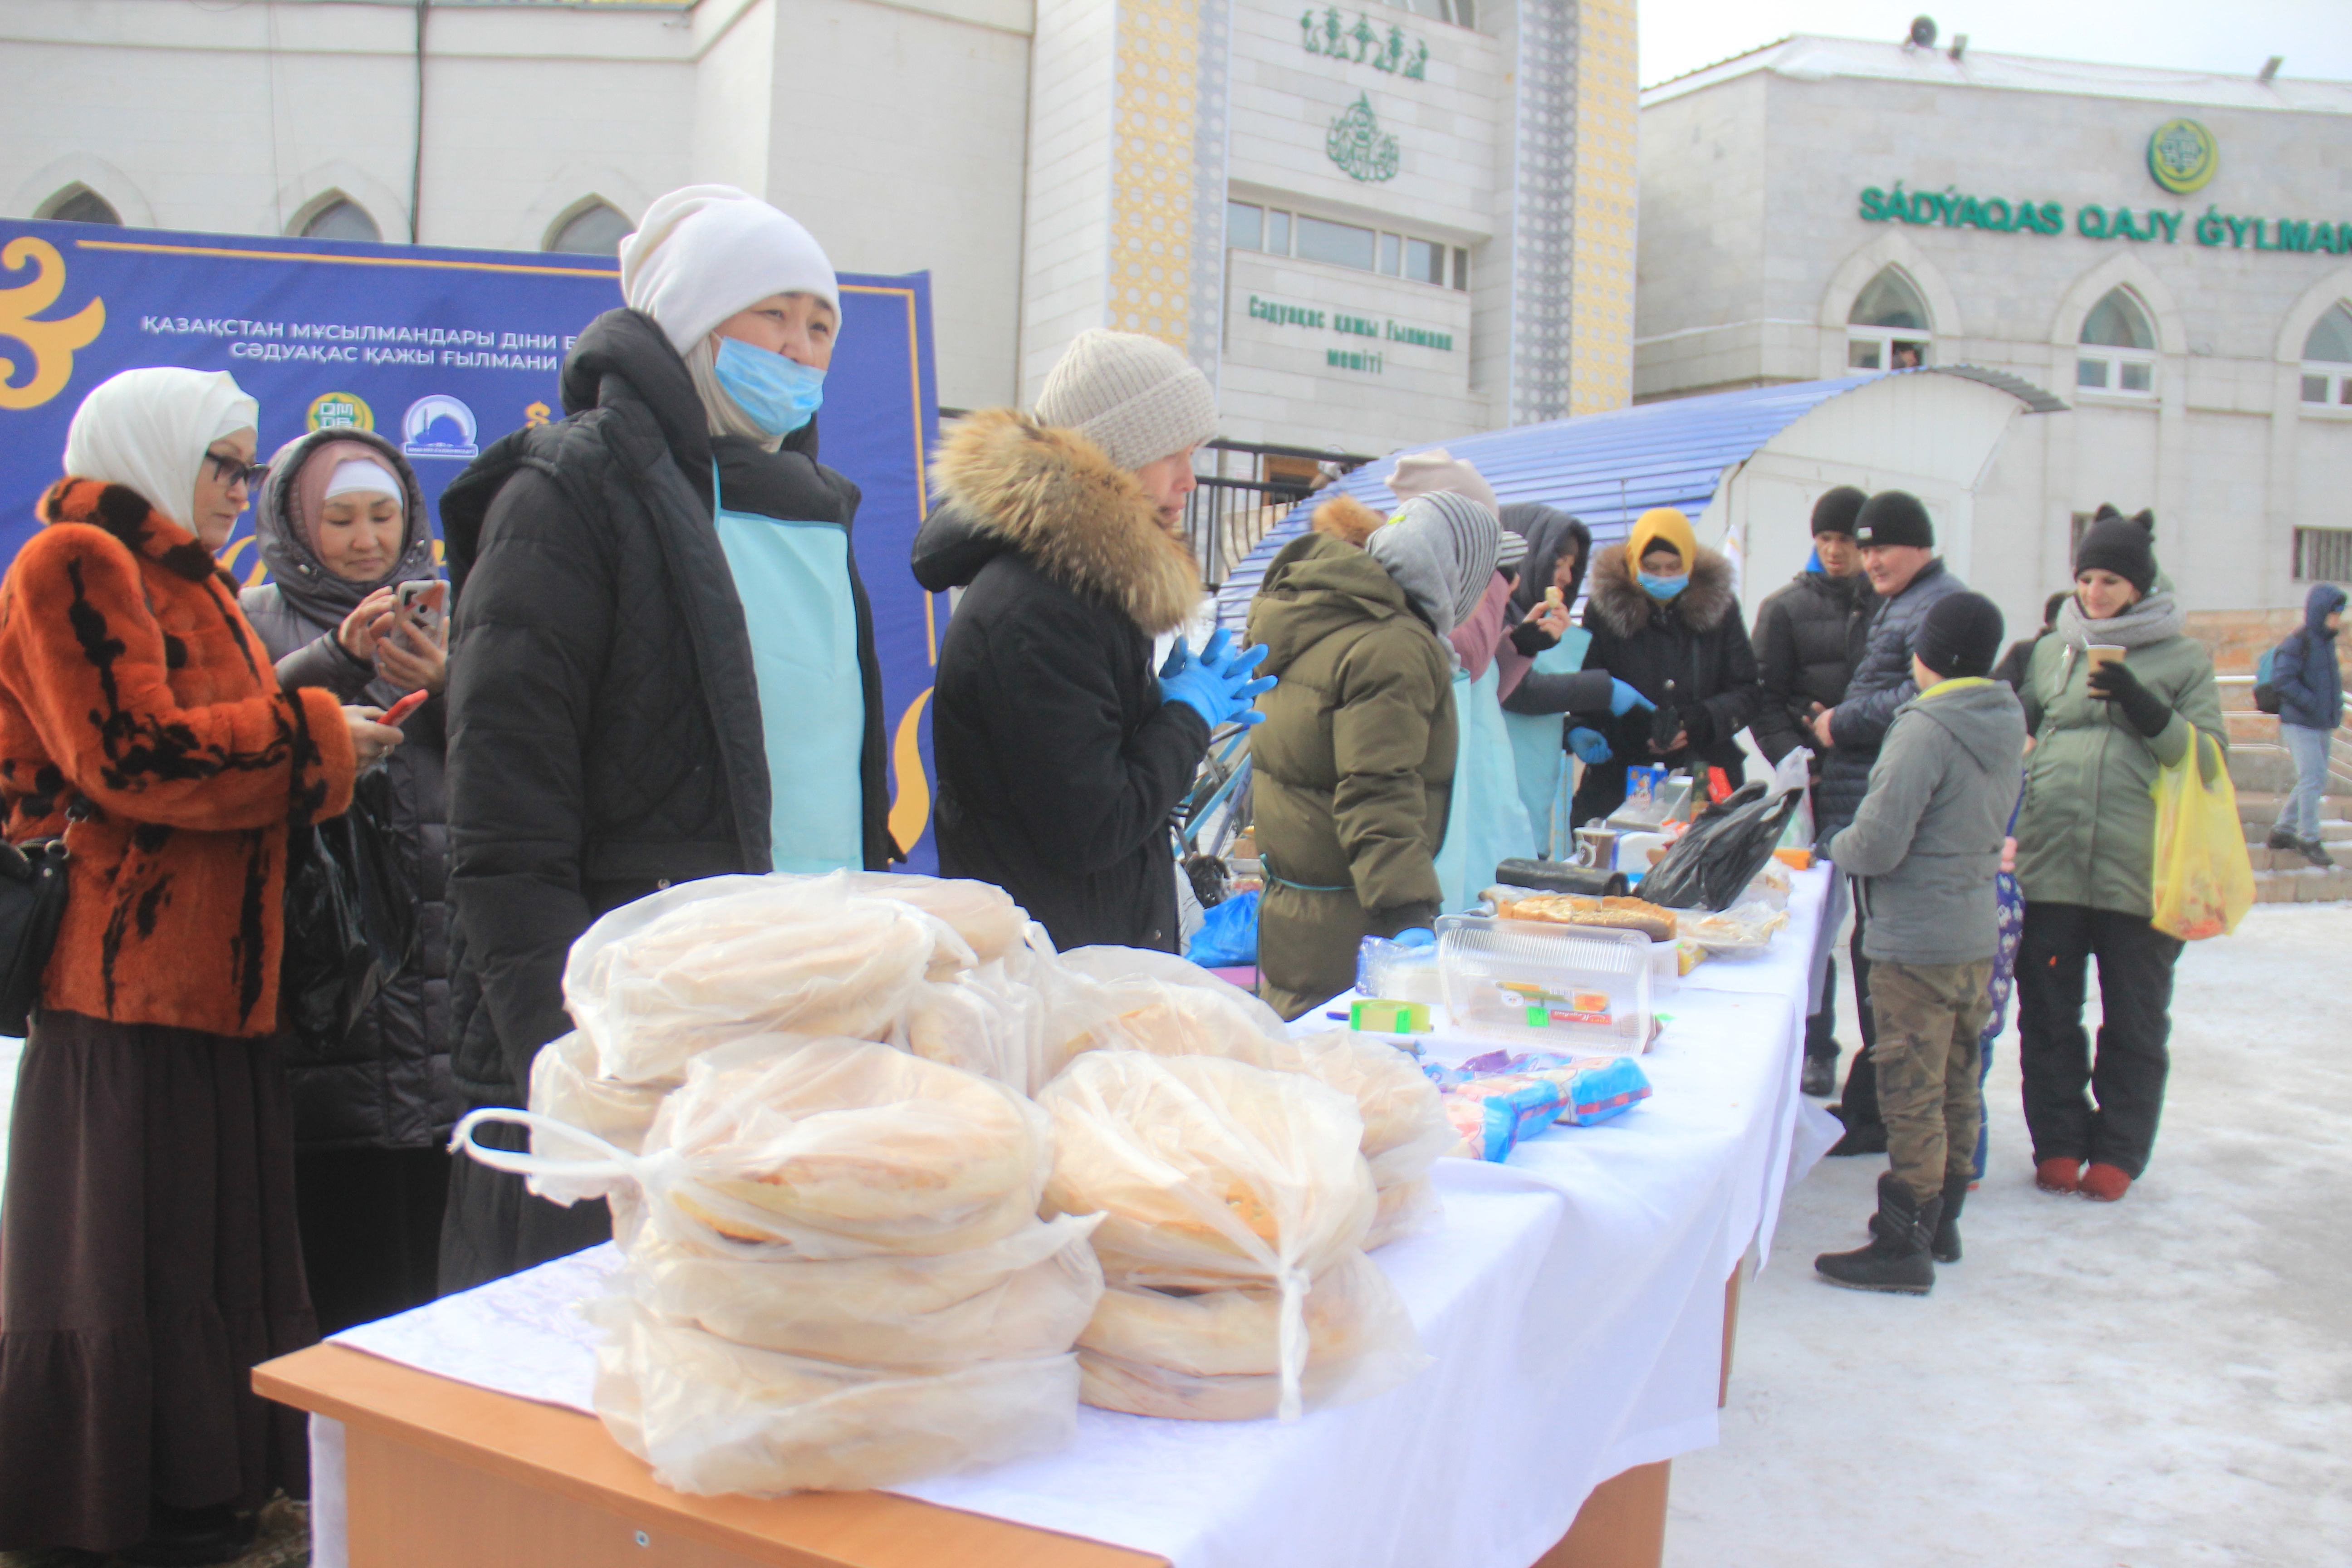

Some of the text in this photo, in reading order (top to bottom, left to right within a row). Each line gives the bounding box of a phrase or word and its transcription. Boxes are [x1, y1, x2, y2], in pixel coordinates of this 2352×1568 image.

[1860, 180, 2065, 235] SÁDÝAQAS
[2078, 204, 2185, 244] QAJY
[143, 316, 284, 337] ҚАЗАҚСТАН
[292, 323, 495, 347] МҰСЫЛМАНДАРЫ
[500, 333, 557, 349] ДІНИ
[230, 342, 558, 370] СӘДУАҚАС ҚАЖЫ ҒЫЛМАНИ
